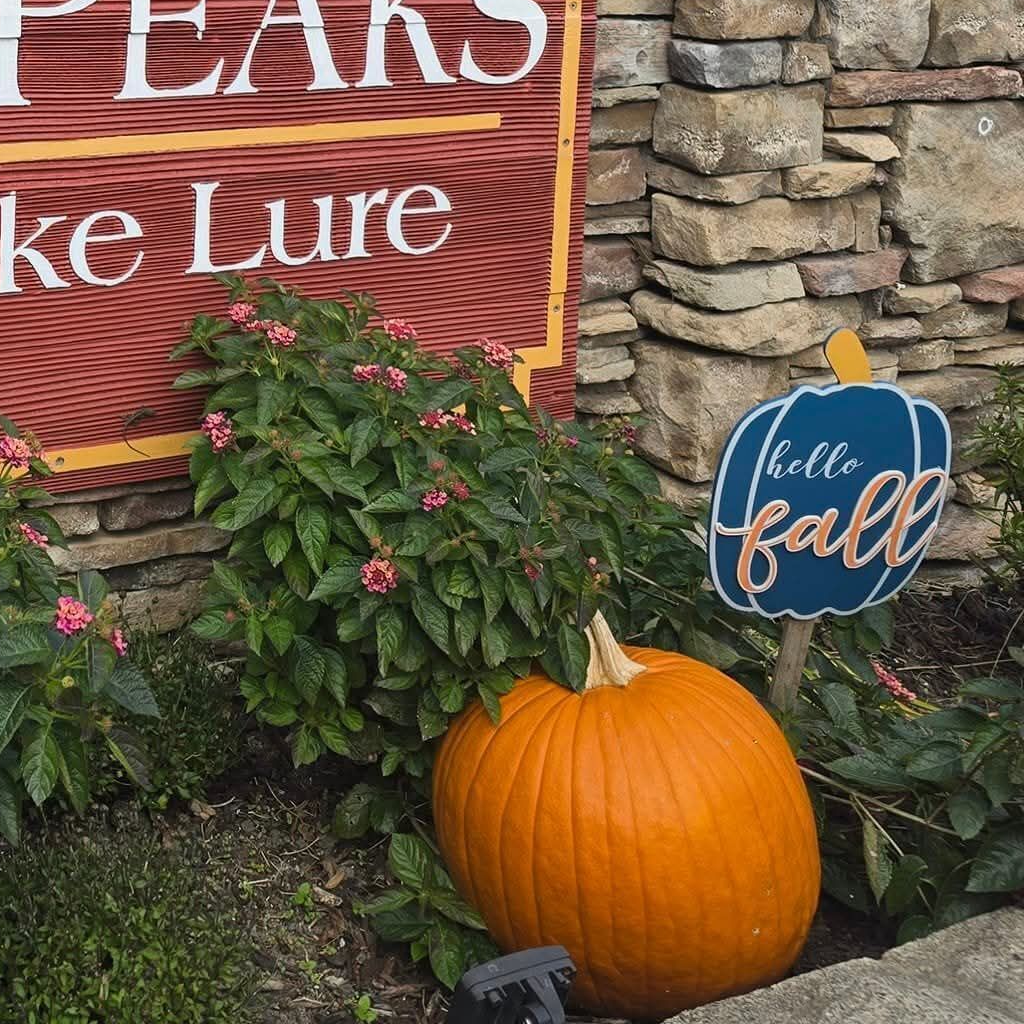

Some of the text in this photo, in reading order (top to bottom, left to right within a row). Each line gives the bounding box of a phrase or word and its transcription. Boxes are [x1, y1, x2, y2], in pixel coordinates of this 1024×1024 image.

[185, 181, 453, 274] Lure
[765, 439, 864, 479] hello
[714, 469, 946, 594] fall
